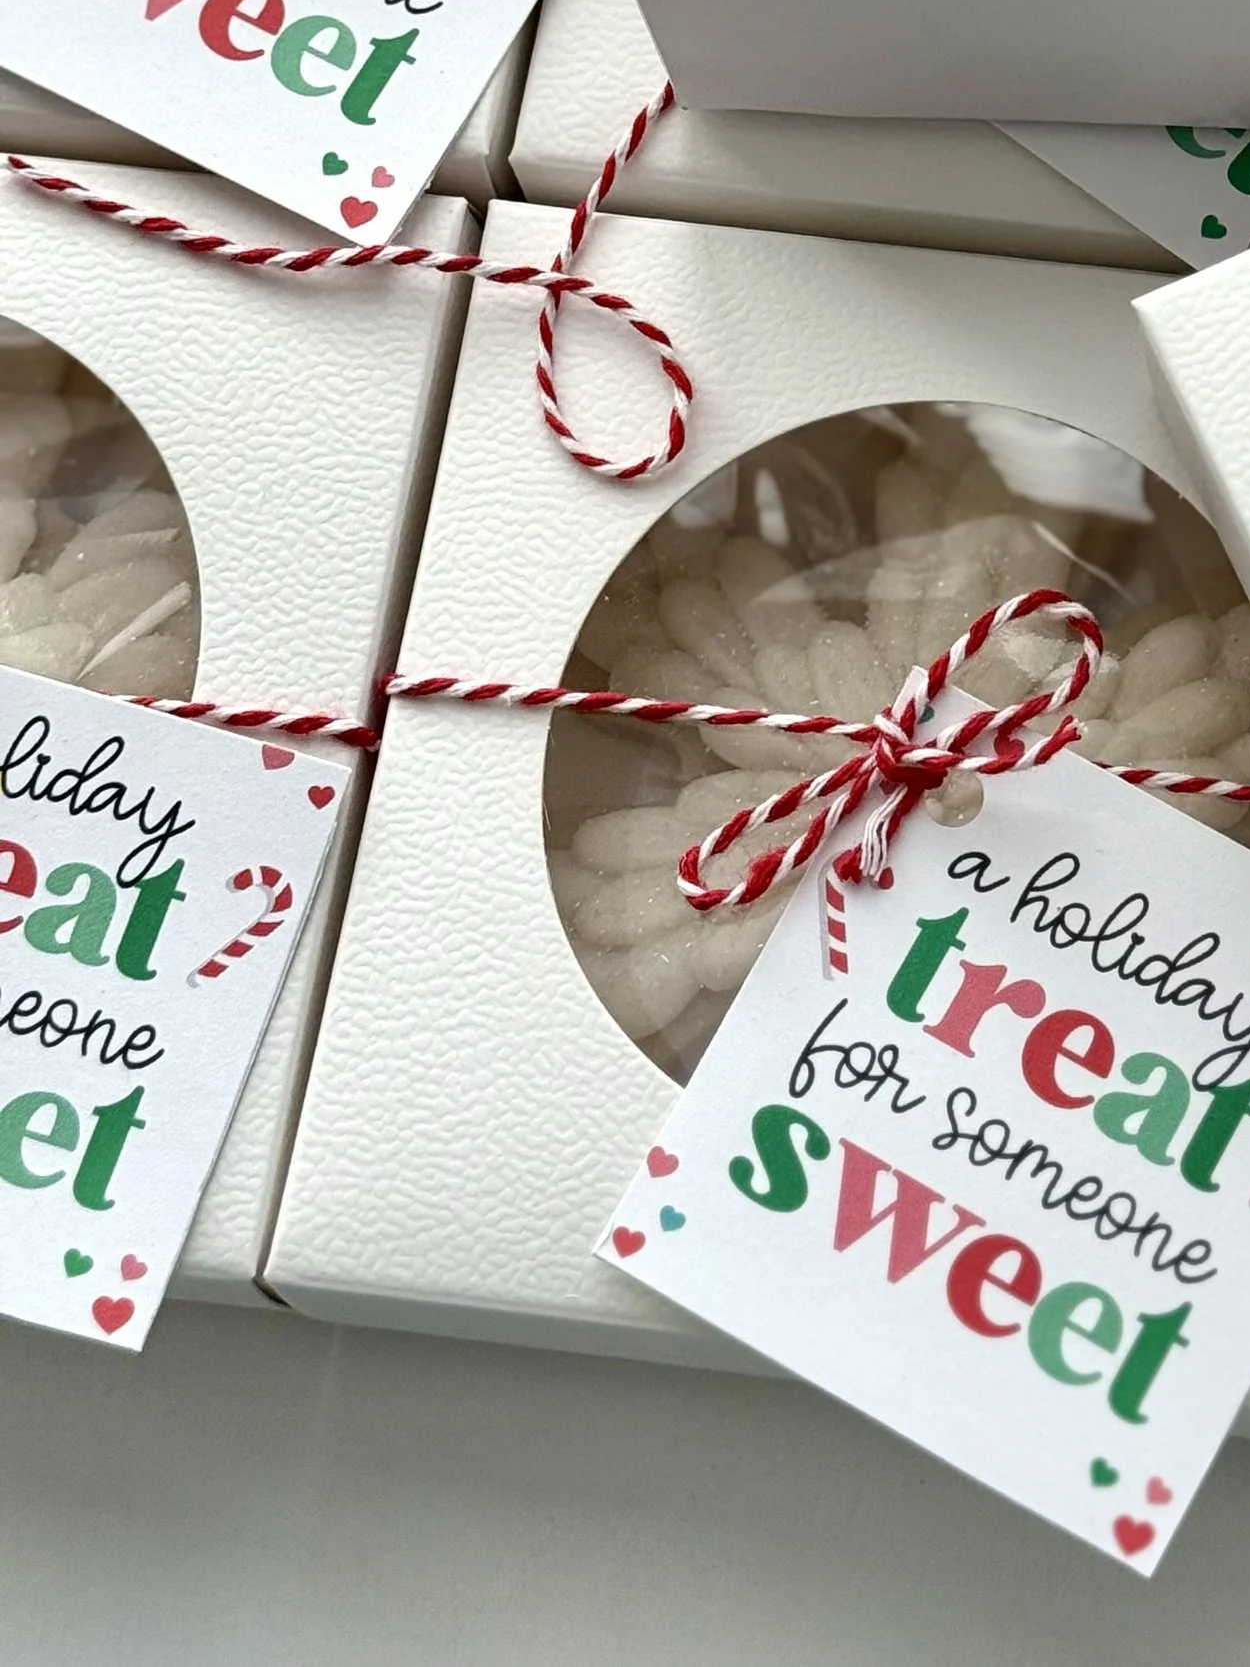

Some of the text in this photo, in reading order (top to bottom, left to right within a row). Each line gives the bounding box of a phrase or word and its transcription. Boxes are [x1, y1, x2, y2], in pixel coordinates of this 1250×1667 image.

[947, 850, 1010, 894] a
[727, 1103, 1192, 1426] sweet
[789, 998, 1218, 1286] for someone
